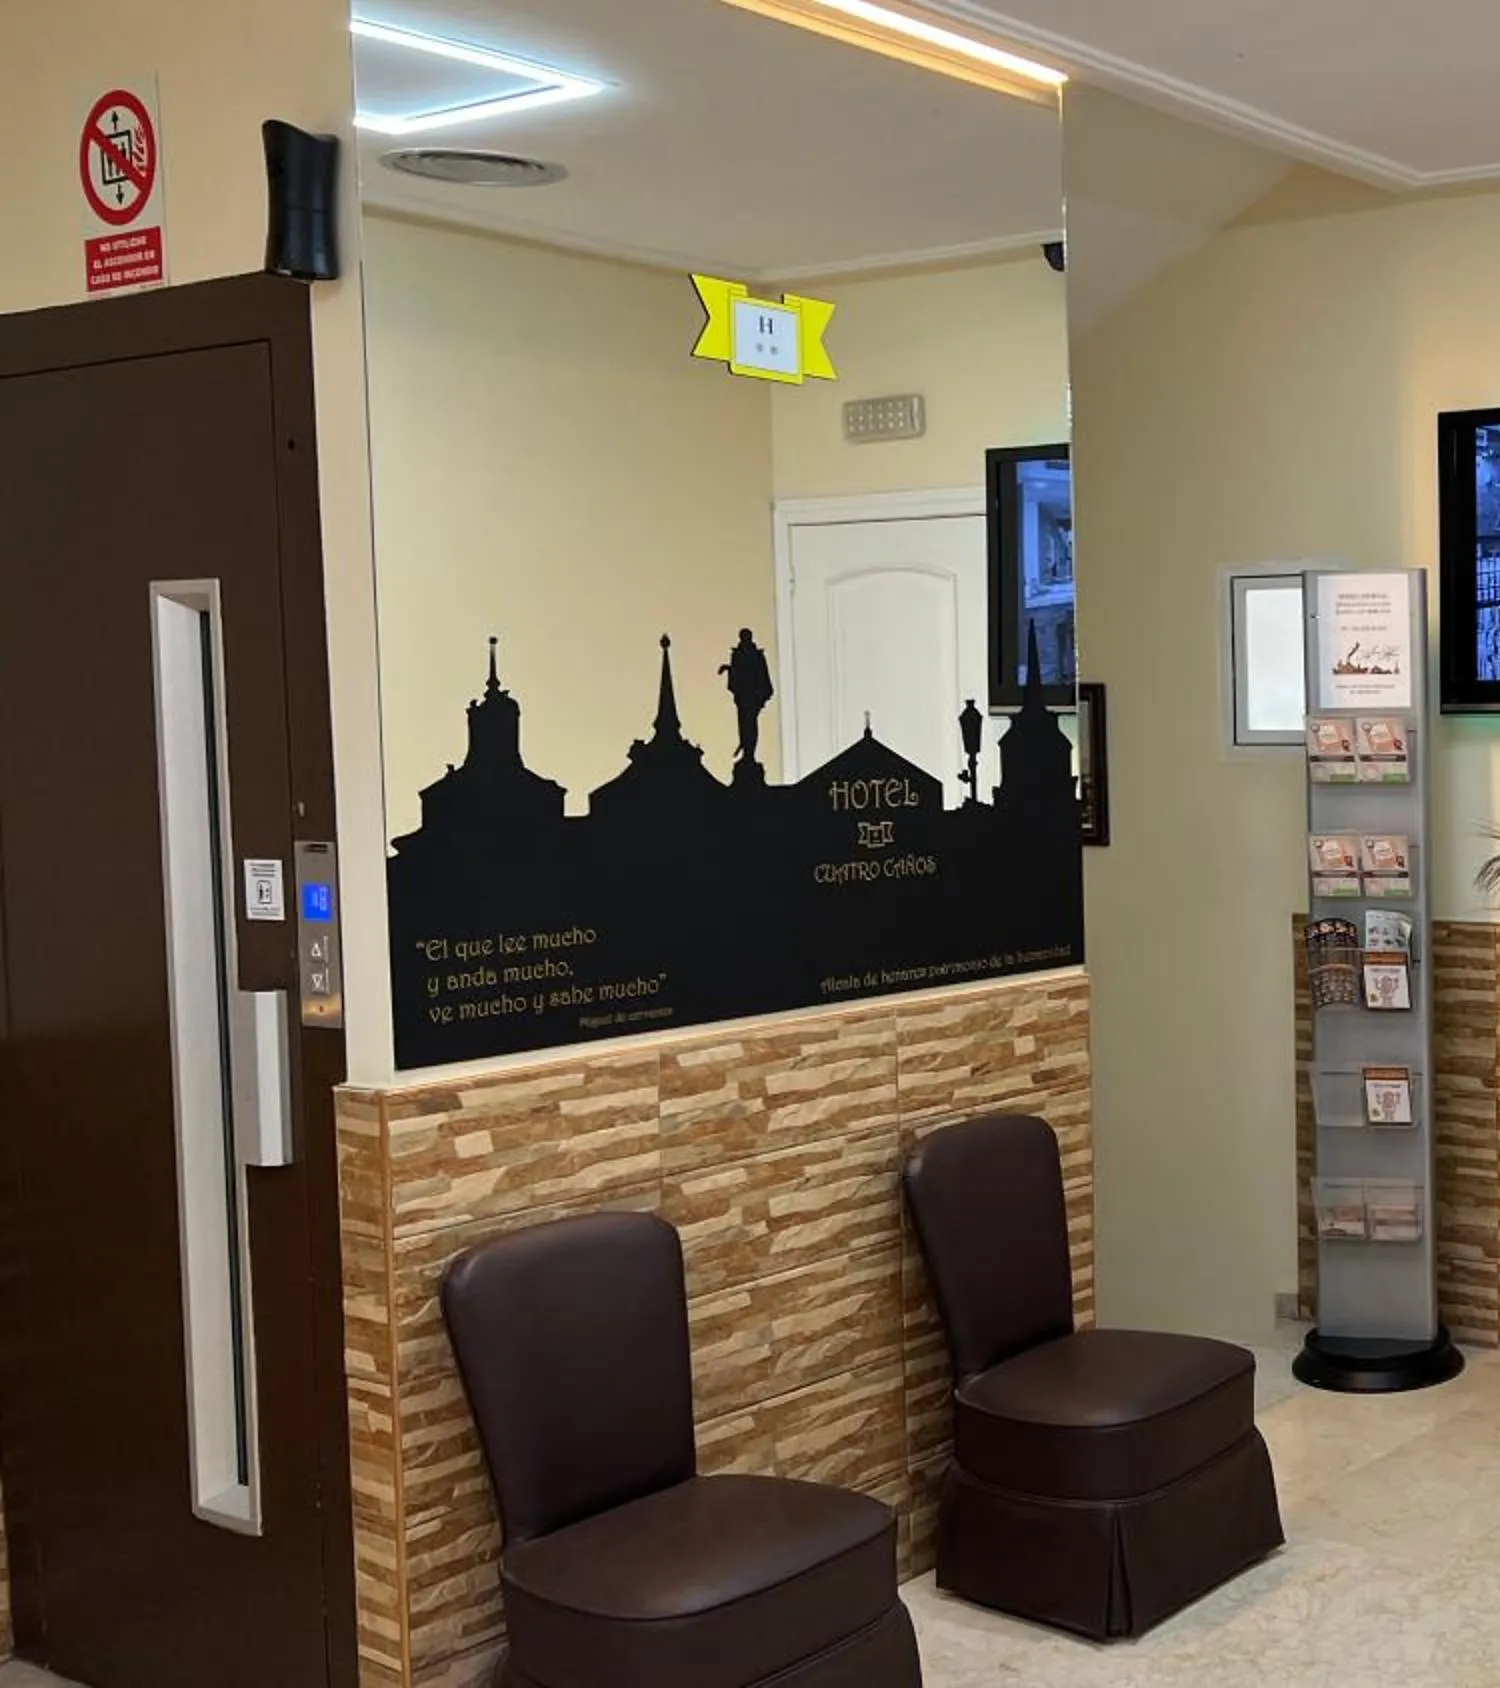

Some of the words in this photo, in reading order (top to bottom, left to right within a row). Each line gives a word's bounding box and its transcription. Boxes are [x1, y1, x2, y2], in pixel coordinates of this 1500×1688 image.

[759, 315, 774, 335] H
[829, 779, 919, 812] HOTEL
[813, 860, 881, 885] CUATRO
[883, 853, 938, 879] CAÑOS
[454, 937, 495, 963] que
[499, 933, 528, 955] lee
[531, 926, 597, 951] mucho
[427, 975, 440, 998] y
[446, 966, 497, 992] anda
[429, 1005, 453, 1024] ve
[459, 996, 527, 1020] mucho
[532, 995, 545, 1016] y
[549, 983, 596, 1008] sabe
